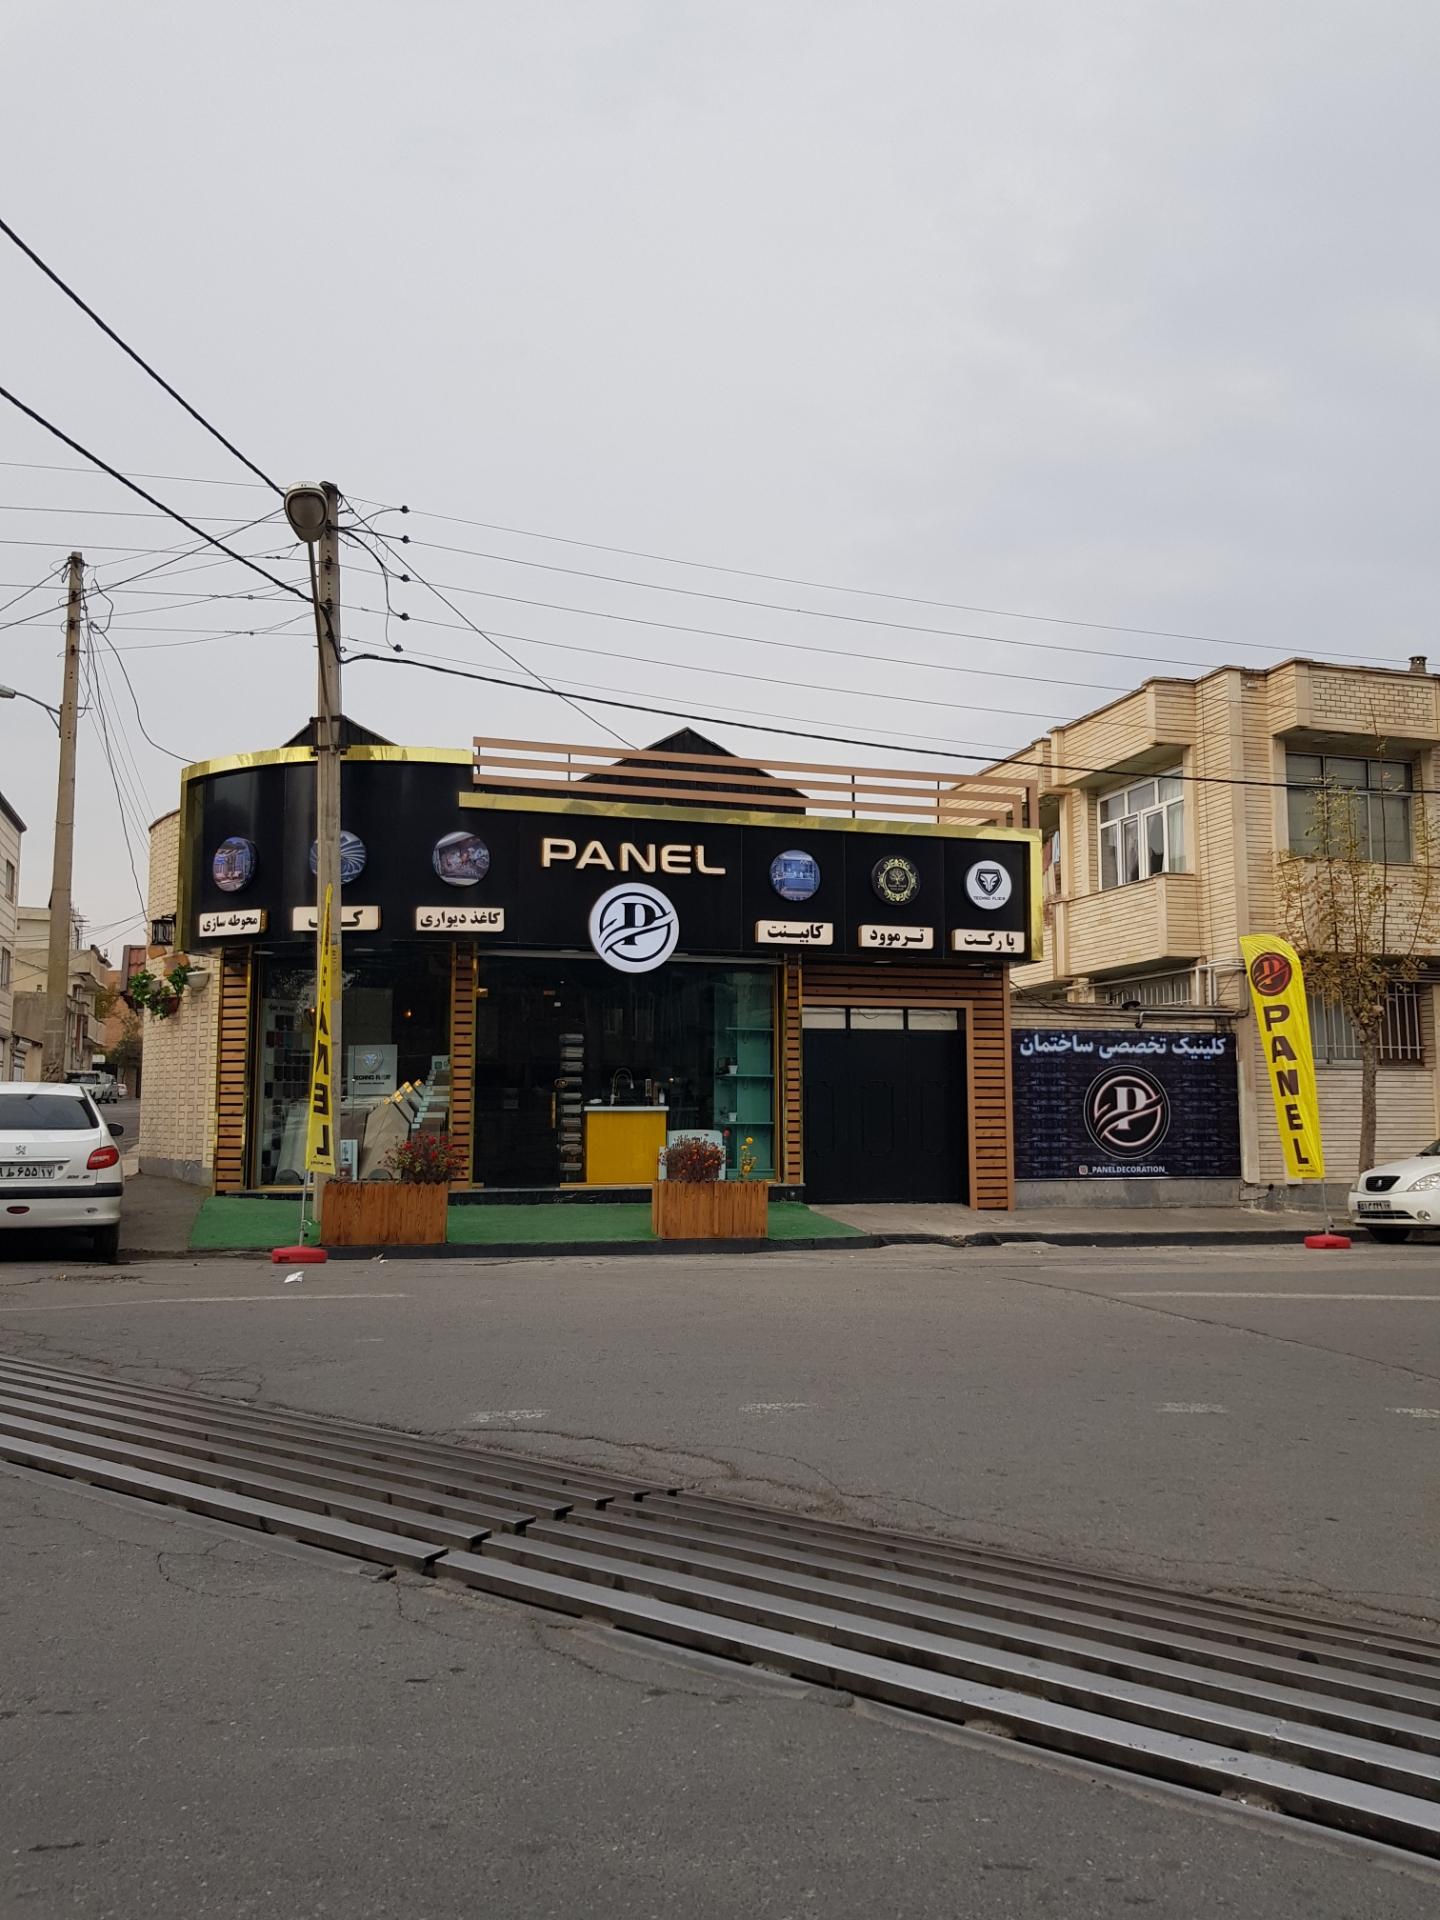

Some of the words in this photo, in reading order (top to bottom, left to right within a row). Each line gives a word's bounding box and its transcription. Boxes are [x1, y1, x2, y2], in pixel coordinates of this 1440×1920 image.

[541, 837, 727, 876] PANEL
[202, 915, 226, 932] سازی
[227, 914, 258, 931] محوطه
[420, 911, 467, 928] دیواری
[469, 910, 501, 925] کاغذ
[766, 923, 824, 943] کابینت
[869, 928, 924, 947] ترموود
[1019, 1033, 1094, 1056] ساختمان
[1099, 1036, 1167, 1059] تخصصی
[1171, 1037, 1227, 1060] کلینیک
[1264, 1003, 1310, 1165] PANEL
